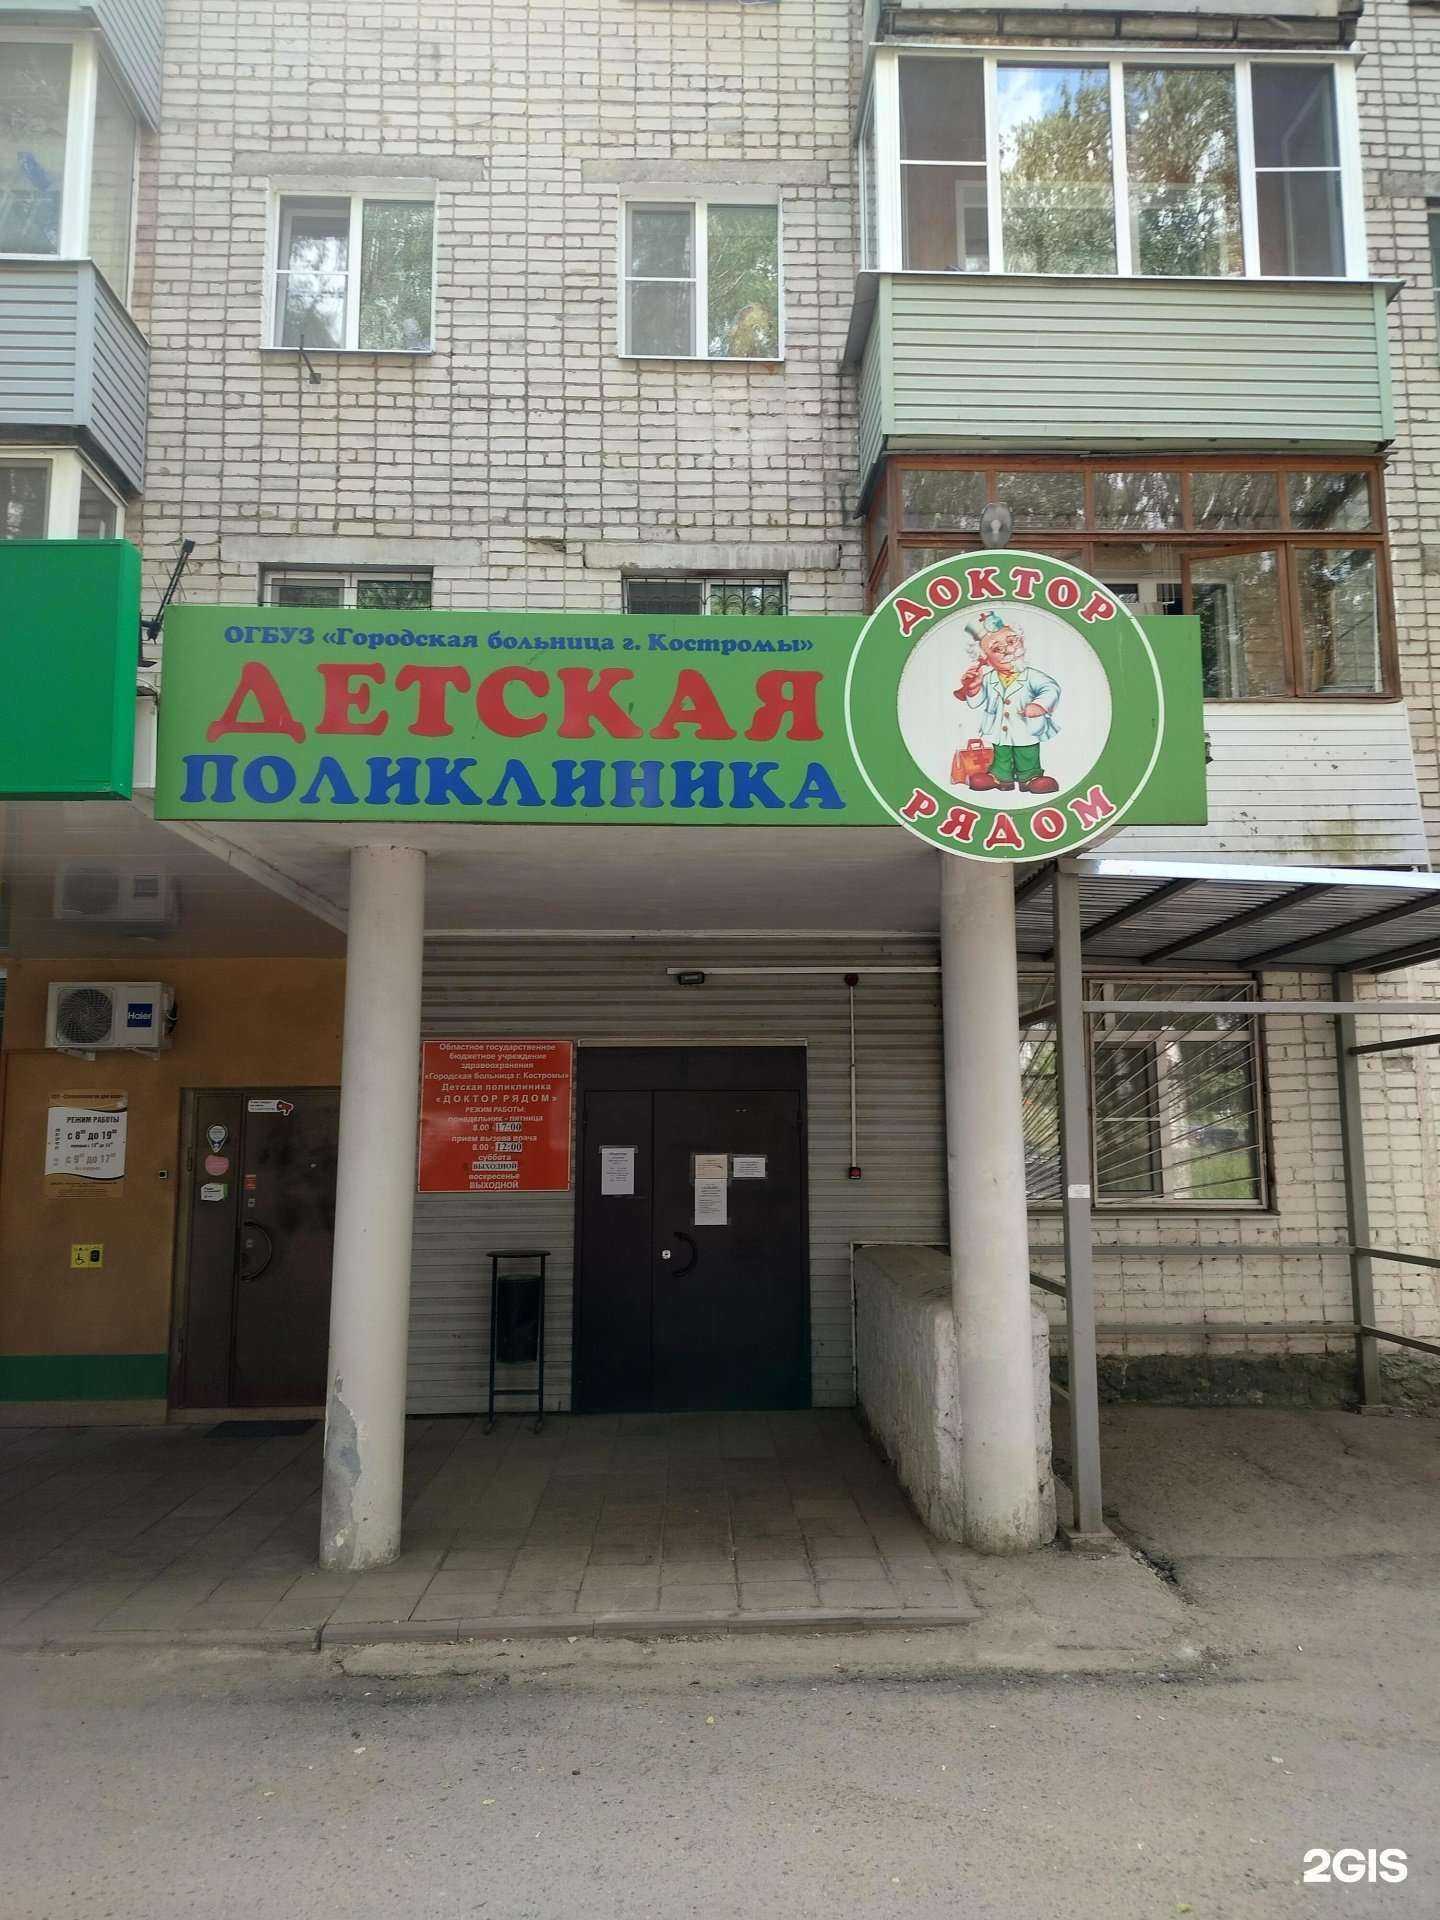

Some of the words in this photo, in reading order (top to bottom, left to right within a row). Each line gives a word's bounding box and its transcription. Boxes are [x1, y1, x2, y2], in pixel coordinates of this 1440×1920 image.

[893, 567, 1117, 637] ДОКТОР
[224, 626, 314, 645] ОГБУЗ
[323, 627, 478, 650] «Городская
[487, 630, 615, 652] больница
[622, 637, 641, 650] г.
[648, 633, 814, 656] Костромы»
[206, 661, 824, 744] ДЕТСКАЯ
[180, 754, 846, 810] ПОЛИКЛИНИКА
[900, 785, 1117, 850] РЯДОМ
[128, 1011, 152, 1020] Haier
[439, 1043, 484, 1051] Областное
[486, 1044, 556, 1052] государственное
[441, 1083, 483, 1092] Детская
[486, 1083, 552, 1091] поликлиника
[66, 1116, 92, 1124] РЕЖИМ
[93, 1116, 120, 1124] РАБОТЫ
[478, 1153, 512, 1161] суббота
[469, 1180, 519, 1189] ВЫХОДНОЙ
